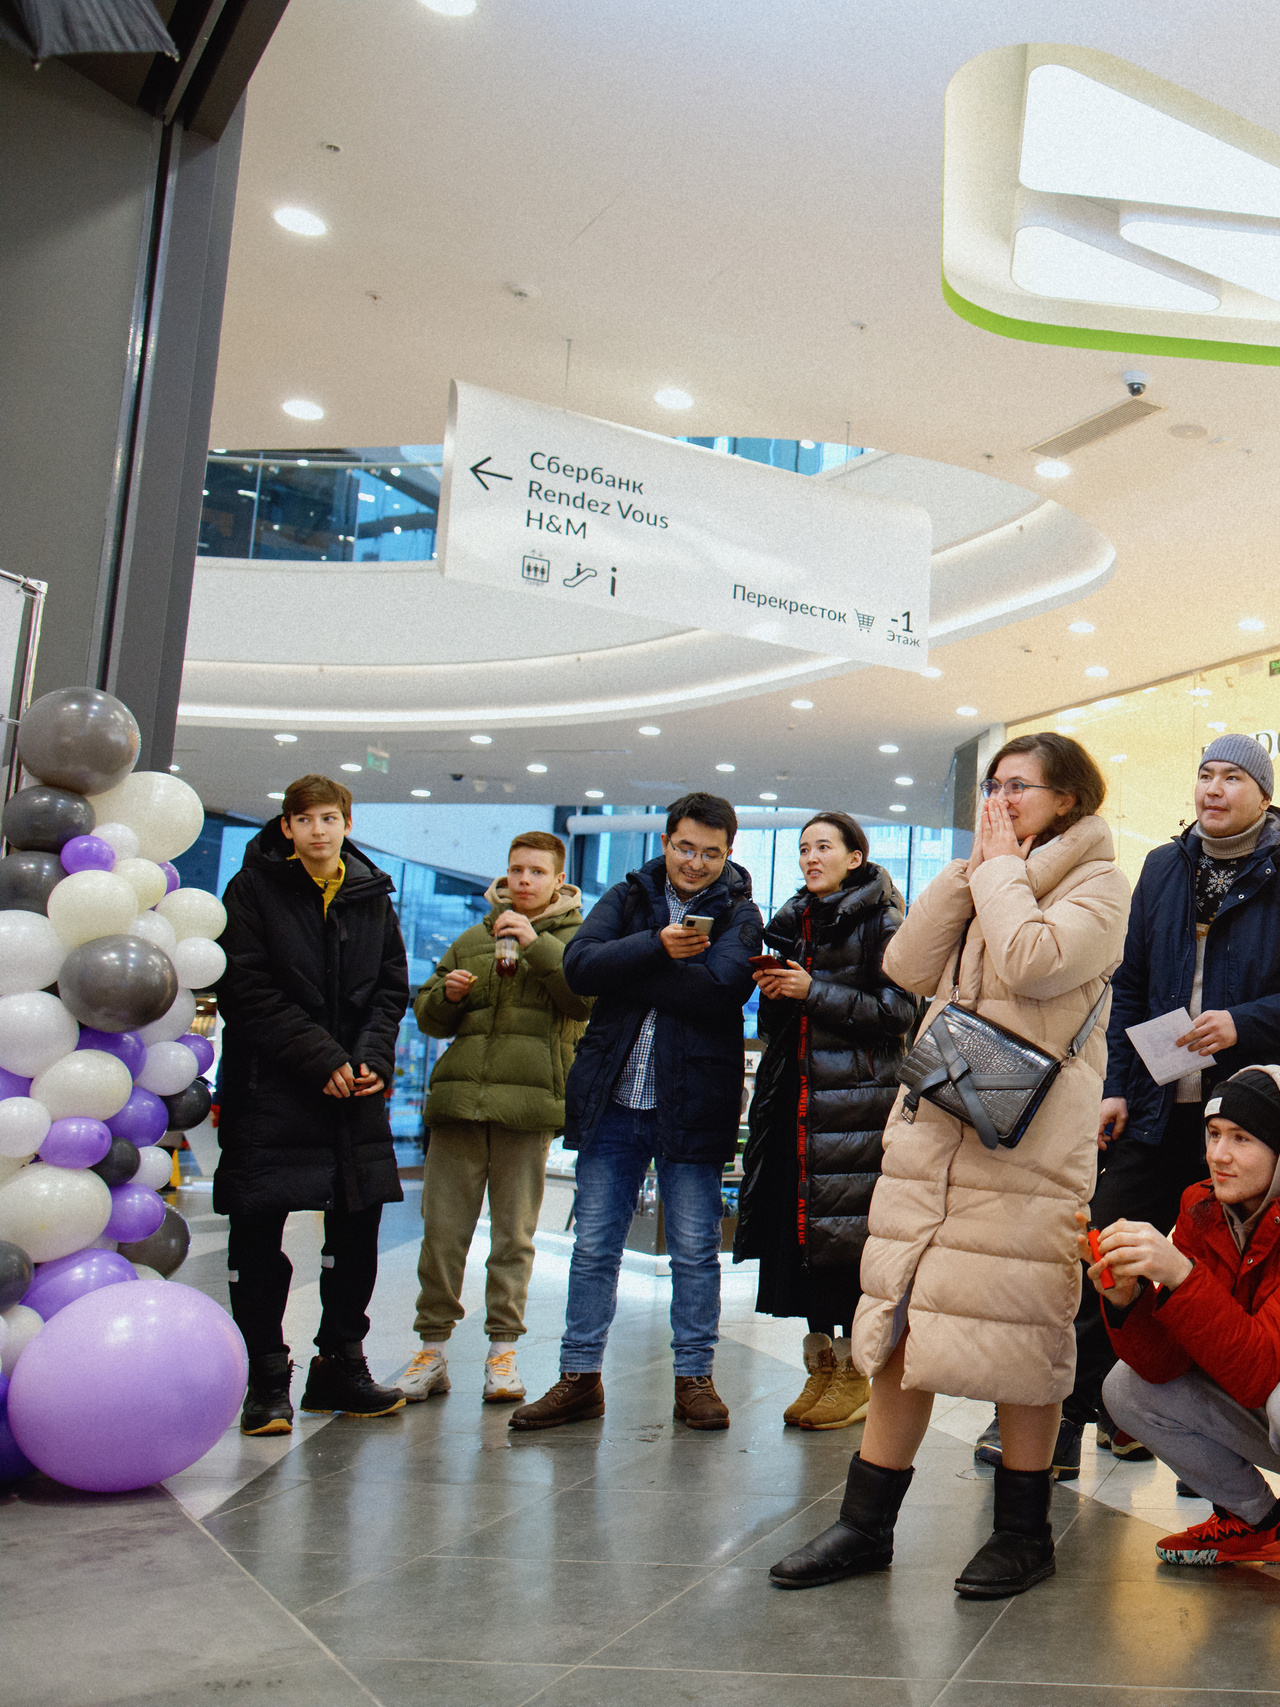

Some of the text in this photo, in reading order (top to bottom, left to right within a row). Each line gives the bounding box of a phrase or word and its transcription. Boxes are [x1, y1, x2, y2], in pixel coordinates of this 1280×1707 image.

[530, 451, 644, 495] Сбербанк
[528, 480, 669, 529] Rendez Vous
[526, 509, 587, 540] H&M
[733, 584, 847, 624] Перекресток
[887, 630, 920, 647] Этаж
[890, 611, 914, 633] -1
